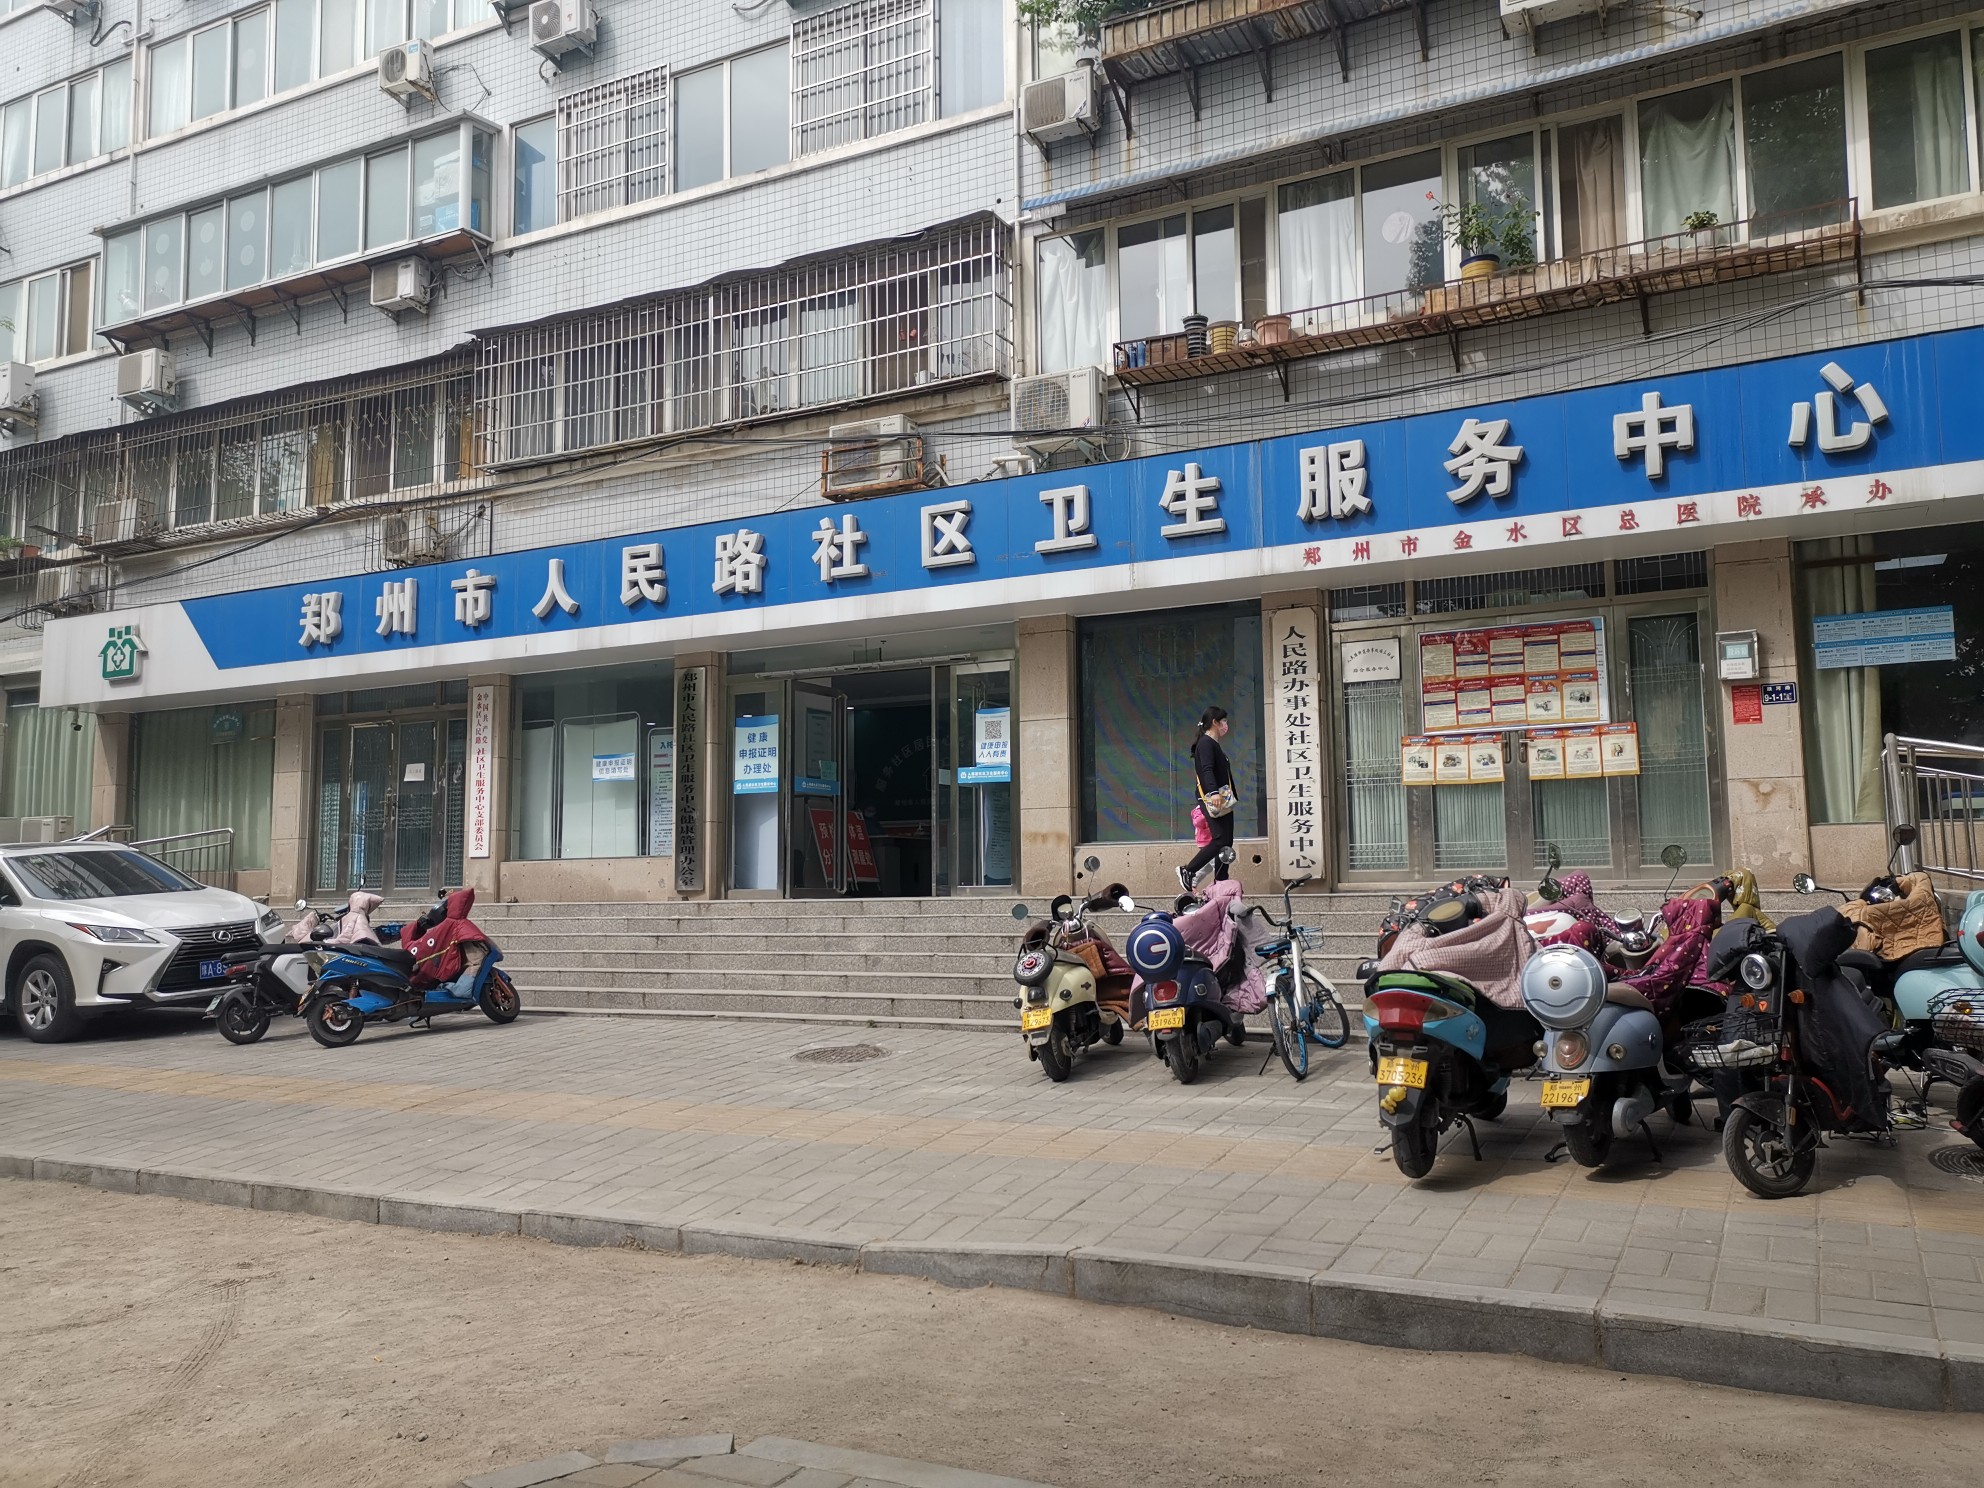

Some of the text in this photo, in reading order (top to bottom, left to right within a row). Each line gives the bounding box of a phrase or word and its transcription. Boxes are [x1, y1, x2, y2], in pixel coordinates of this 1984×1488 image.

[298, 361, 1889, 647] 郑州市人民路社区卫生服务中心
[1303, 479, 1893, 566] 郑州市金水区总医院承办
[475, 693, 483, 744] 金水区人民路
[747, 731, 768, 744] 健康
[980, 741, 1008, 750] 健康申报
[1281, 625, 1317, 869] 人民路办事处社区卫生服务中心
[738, 747, 777, 759] 申报证明
[978, 750, 1007, 758] 人人有责
[596, 758, 632, 767] 健康申报证明
[743, 762, 772, 774] 办理处
[598, 766, 629, 775] 信息填写处
[680, 672, 698, 887] 郑州市人民路社区卫生服务中心健康管理办公室
[475, 748, 487, 851] 社区卫生服务中心支部委员会
[1150, 1016, 1181, 1028] 2319637
[1379, 1069, 1423, 1085] 3705236
